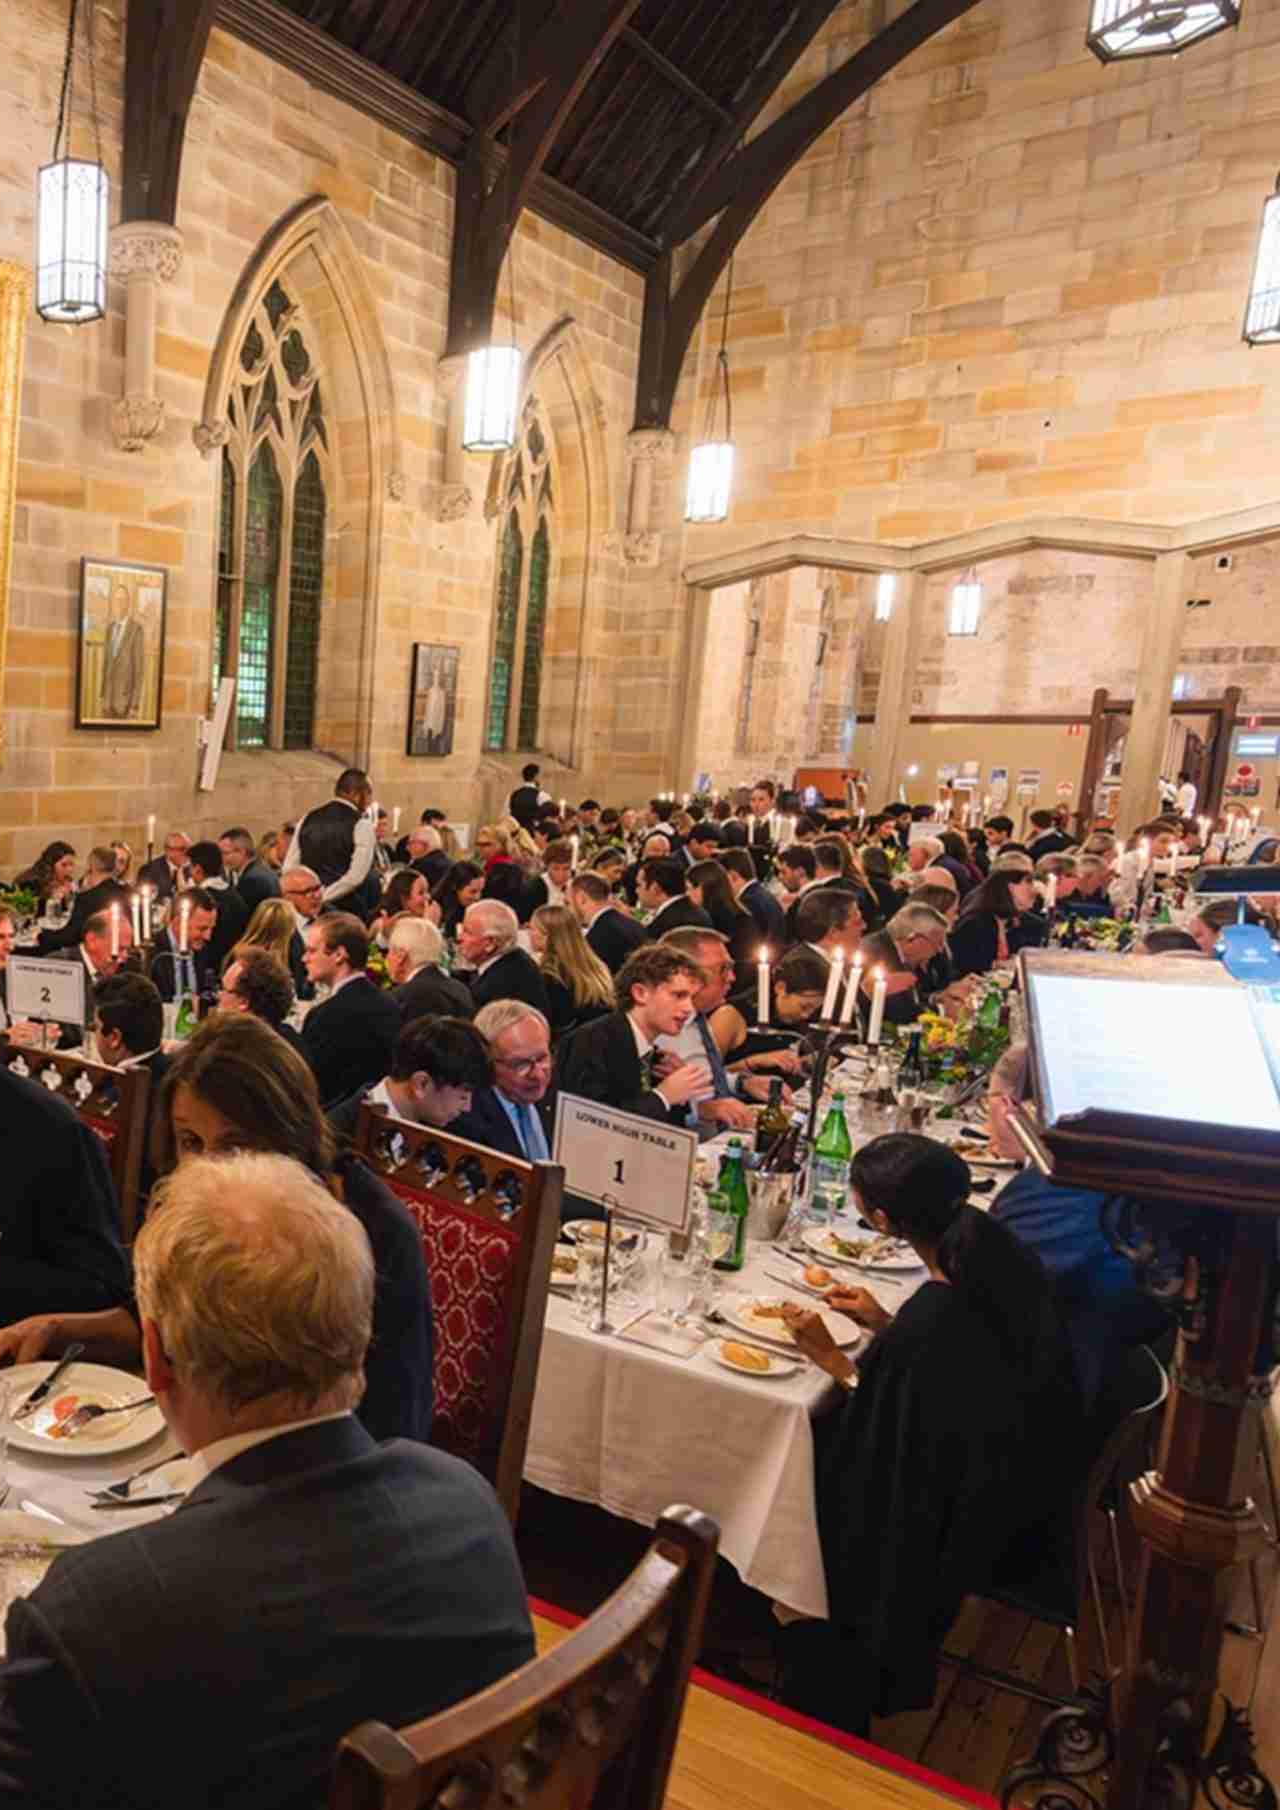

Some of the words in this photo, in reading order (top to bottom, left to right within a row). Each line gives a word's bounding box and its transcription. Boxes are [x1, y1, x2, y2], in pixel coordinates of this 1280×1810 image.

[40, 987, 51, 1003] 2
[576, 1111, 609, 1129] LOWER
[642, 1132, 675, 1150] TABLE
[613, 1159, 625, 1184] 1
